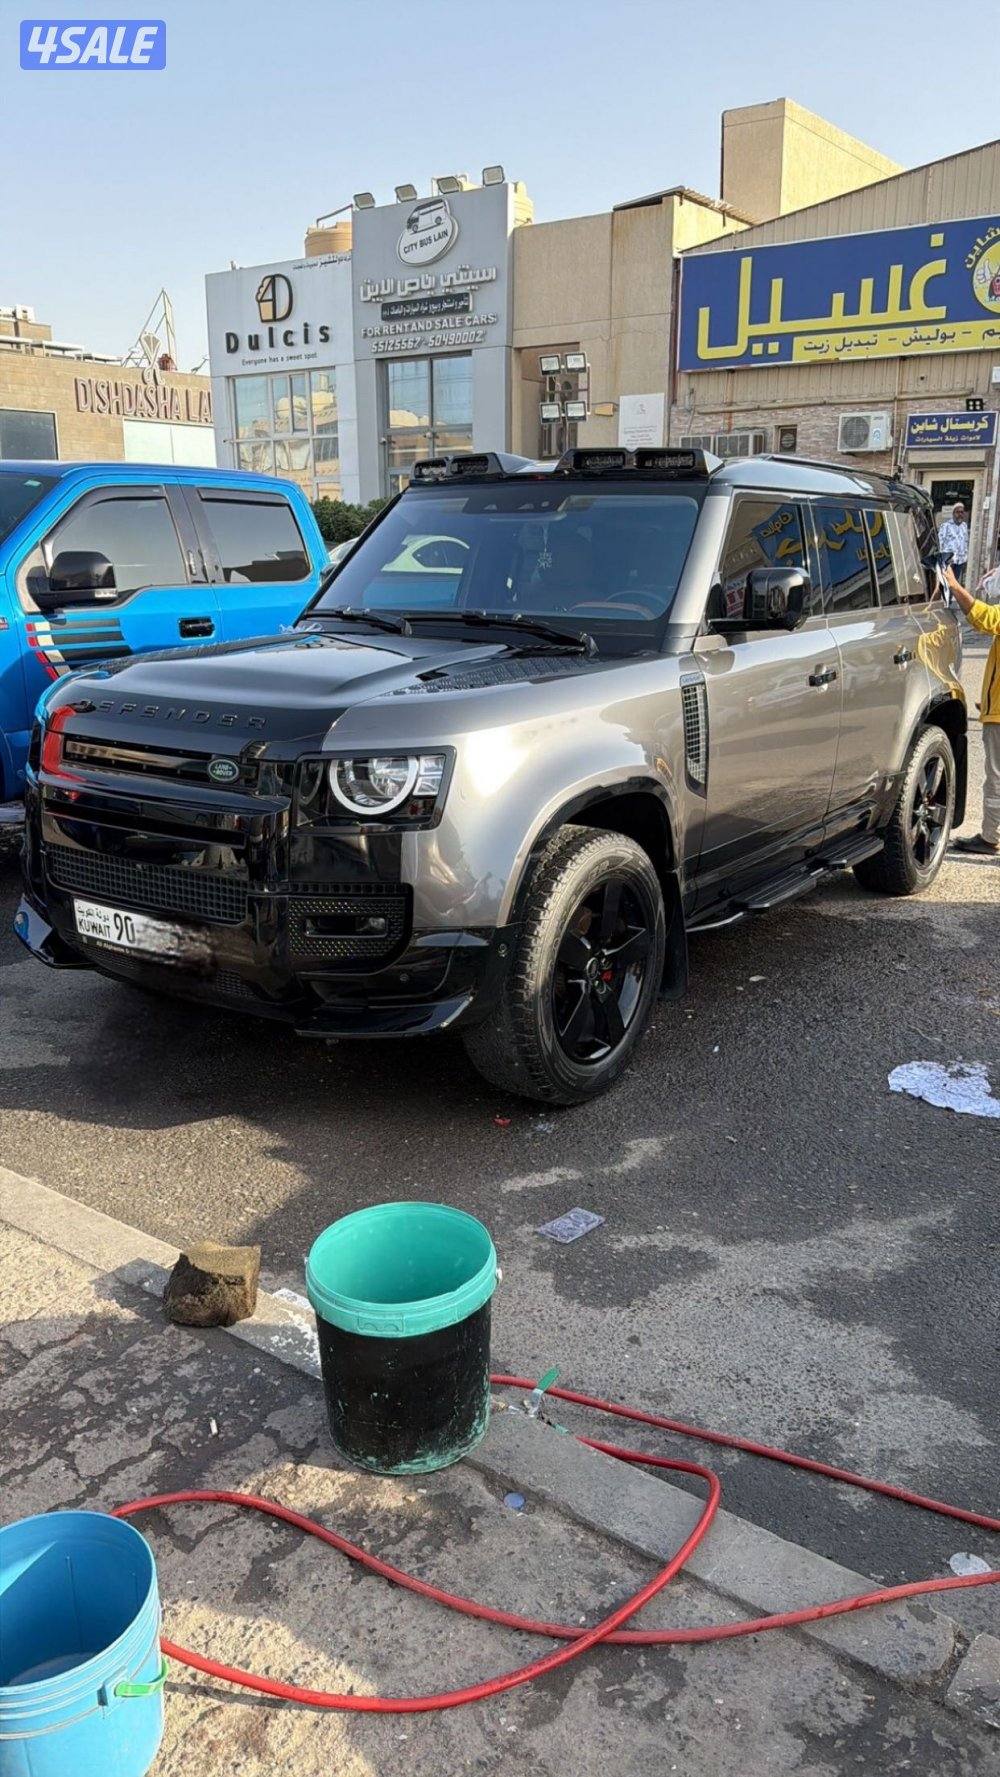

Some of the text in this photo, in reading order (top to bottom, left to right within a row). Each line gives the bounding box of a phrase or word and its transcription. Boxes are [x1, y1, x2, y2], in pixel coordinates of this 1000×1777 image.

[403, 228, 449, 254] CITY BUS LAIN
[697, 232, 947, 360] غسيل
[361, 326, 382, 339] FOR
[382, 321, 410, 336] RENT
[410, 318, 433, 332] AND
[434, 314, 462, 329] SALE
[225, 321, 331, 354] Dulcis
[803, 339, 830, 354] زيت
[834, 334, 878, 352] تبديل
[902, 328, 956, 346] بوليش
[241, 358, 267, 366] Everyone
[75, 376, 182, 420] DISHDASHA
[911, 415, 989, 434] كريستال شاين
[79, 918, 111, 938] KUWAIT
